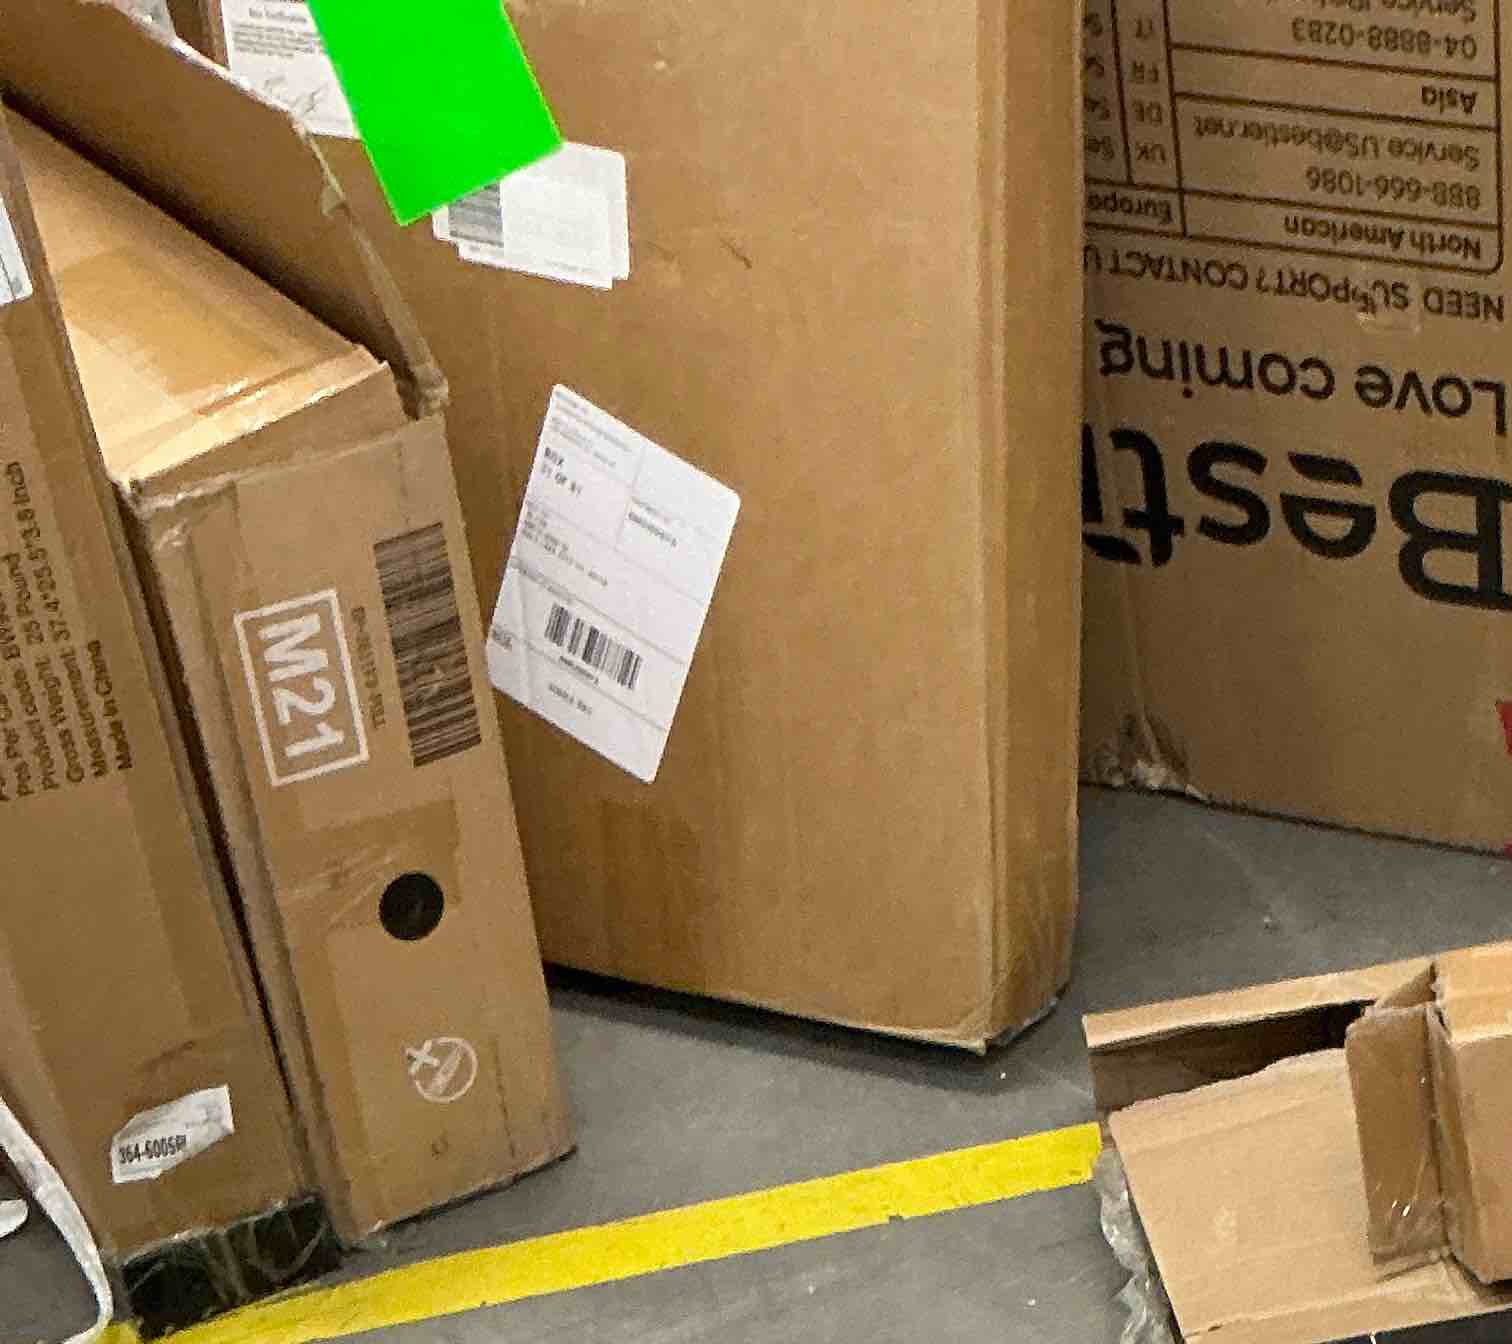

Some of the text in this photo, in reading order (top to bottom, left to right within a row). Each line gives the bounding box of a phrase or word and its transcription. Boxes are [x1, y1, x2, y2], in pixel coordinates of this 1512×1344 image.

[1421, 85, 1479, 115] Asia
[1135, 142, 1167, 164] UK
[1306, 166, 1481, 210] 888-666-1086
[1284, 215, 1481, 261] North American
[1110, 249, 1249, 291] CONTACT
[1423, 286, 1504, 322] NEED
[1095, 317, 1508, 438] Love coming
[88, 640, 133, 770] Made in China
[257, 612, 345, 759] M21
[58, 728, 85, 783] Gross
